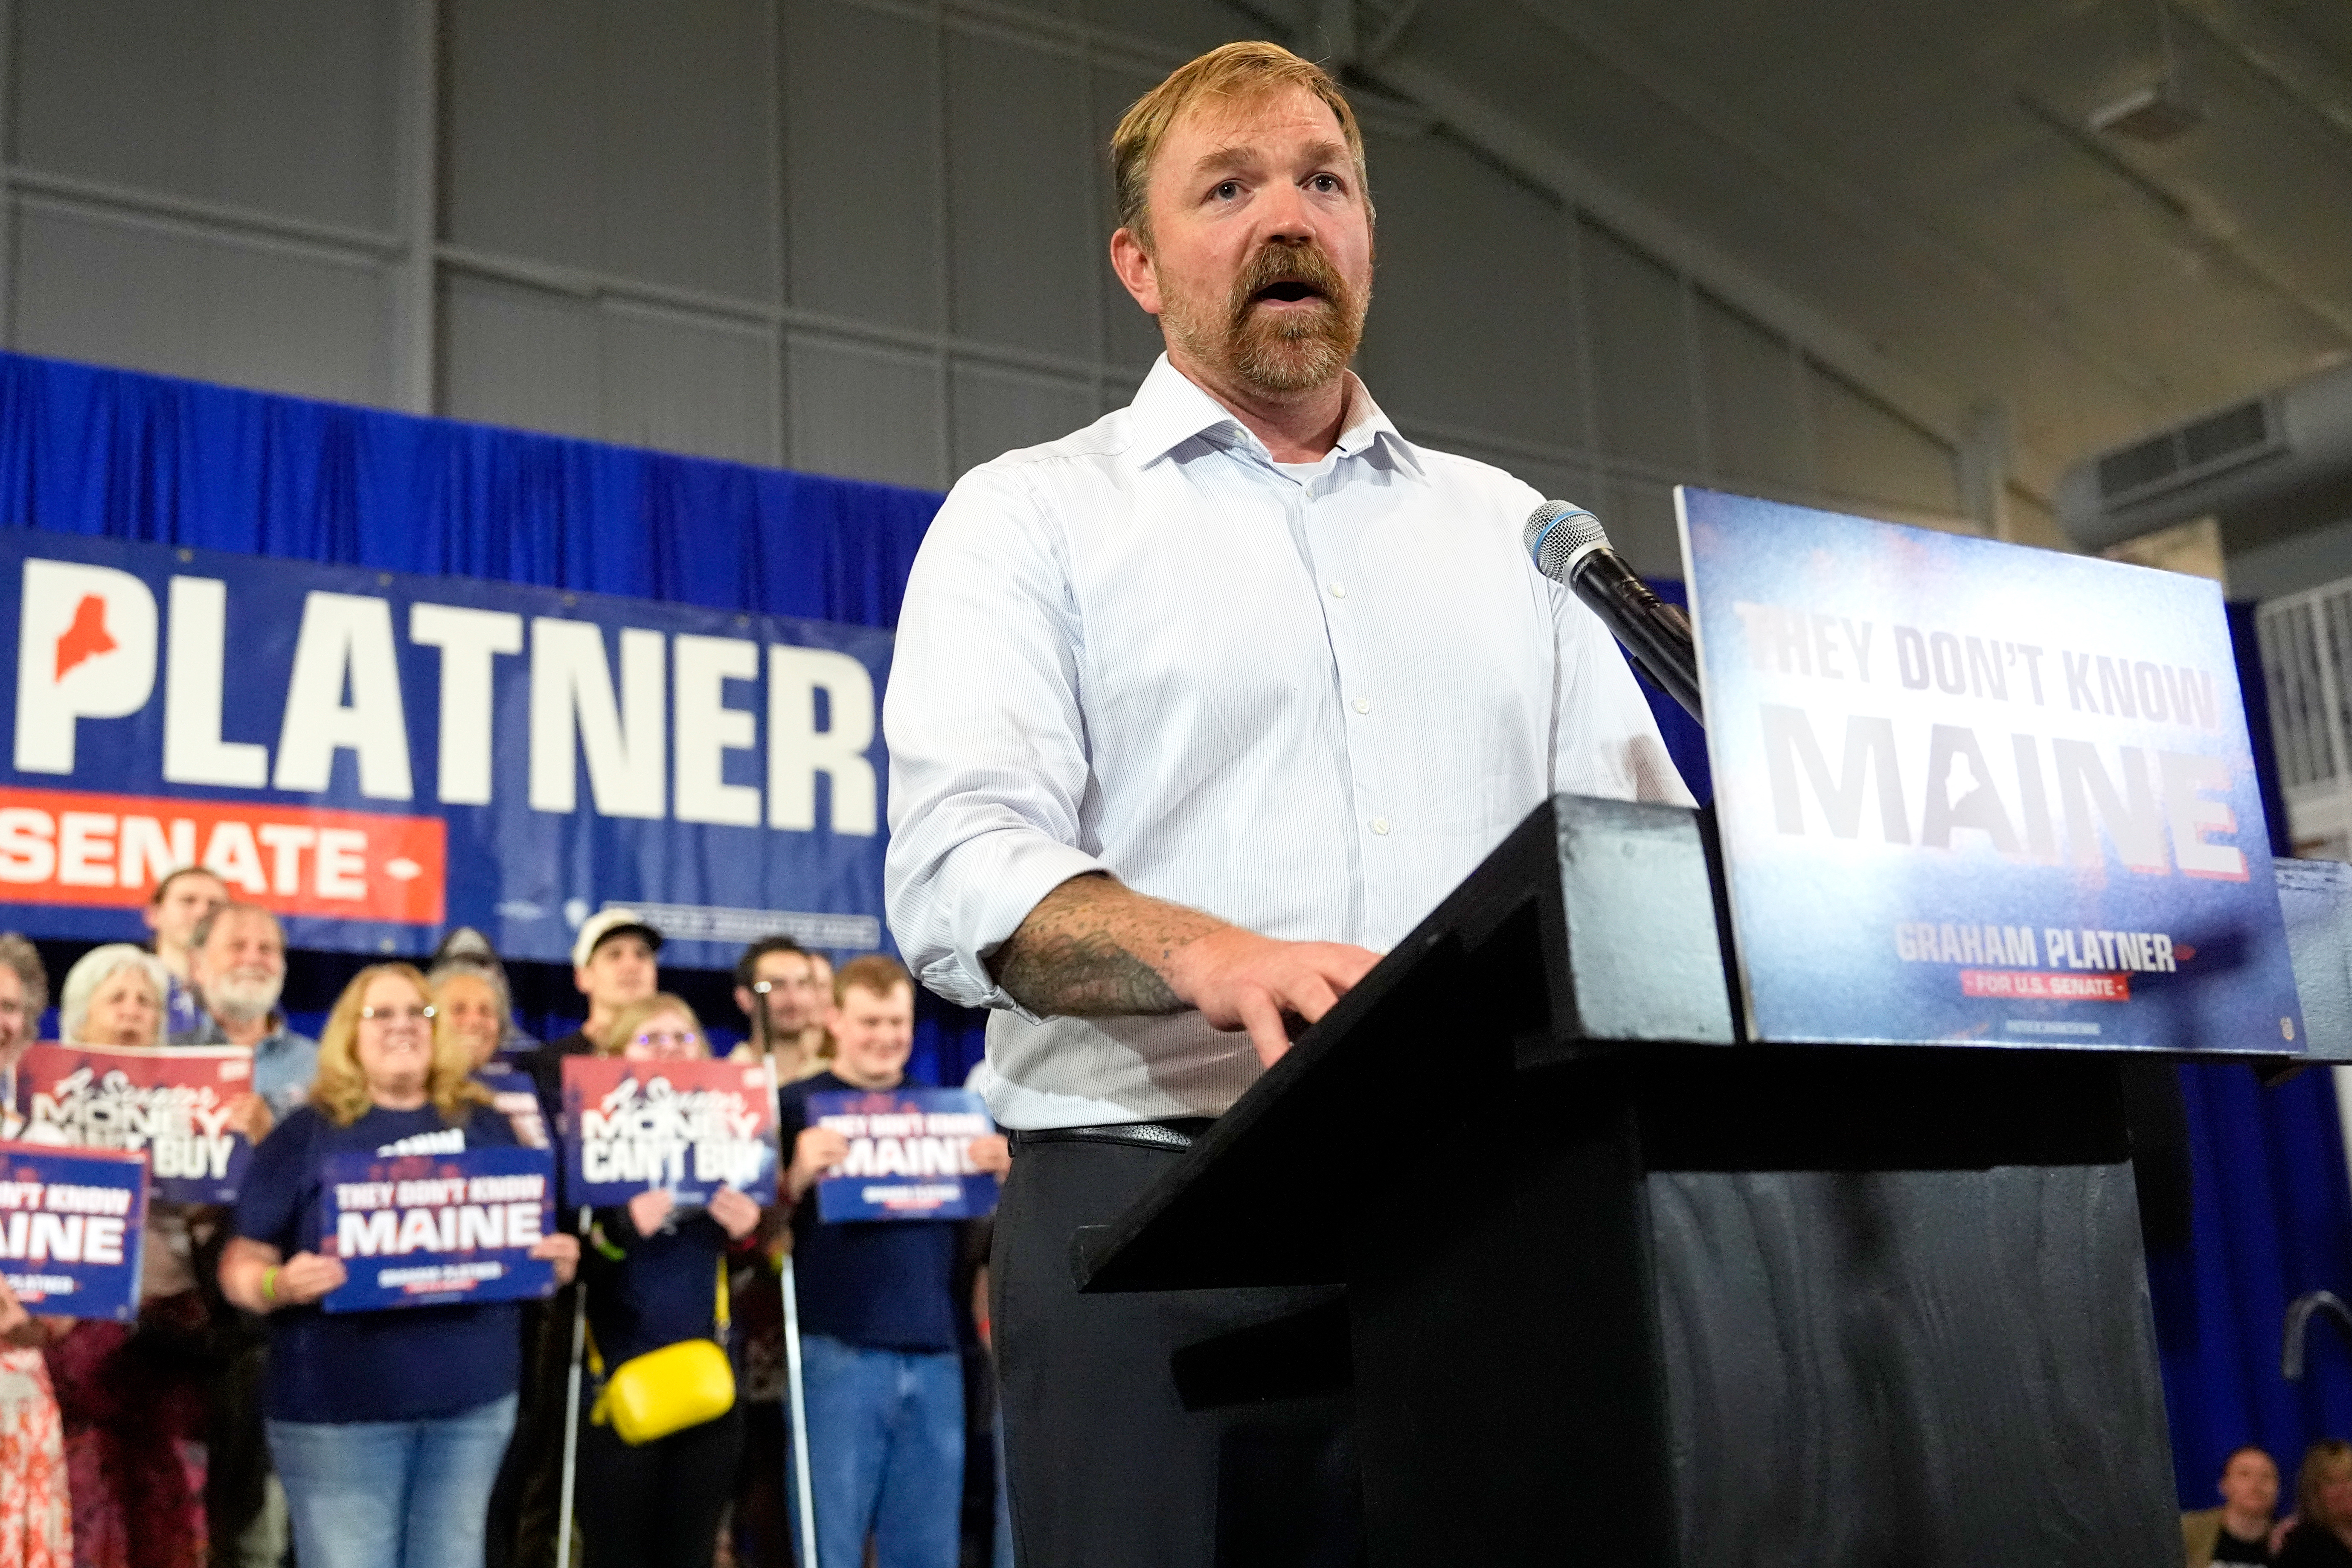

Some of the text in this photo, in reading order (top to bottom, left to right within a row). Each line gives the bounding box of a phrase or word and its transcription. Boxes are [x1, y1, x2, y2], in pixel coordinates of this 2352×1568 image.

[1573, 556, 1592, 583] SHURE
[1733, 601, 2218, 729] THEY DON'T KNOW
[15, 557, 877, 837] PLATNER
[1759, 702, 2247, 878] MAINE
[0, 806, 369, 900] SENATE
[1896, 922, 2177, 972] GRAHAM PLATNER
[1976, 974, 2012, 993] FOR
[2049, 977, 2117, 996] SENATE
[32, 1092, 231, 1138] MONEY
[580, 1108, 761, 1141] MONEY
[152, 1134, 235, 1180] BUY
[694, 1137, 766, 1184] BUY
[334, 1182, 395, 1210] THEY
[468, 1173, 546, 1203] KNOW
[0, 1210, 126, 1265] INE
[336, 1201, 544, 1258] MAINE
